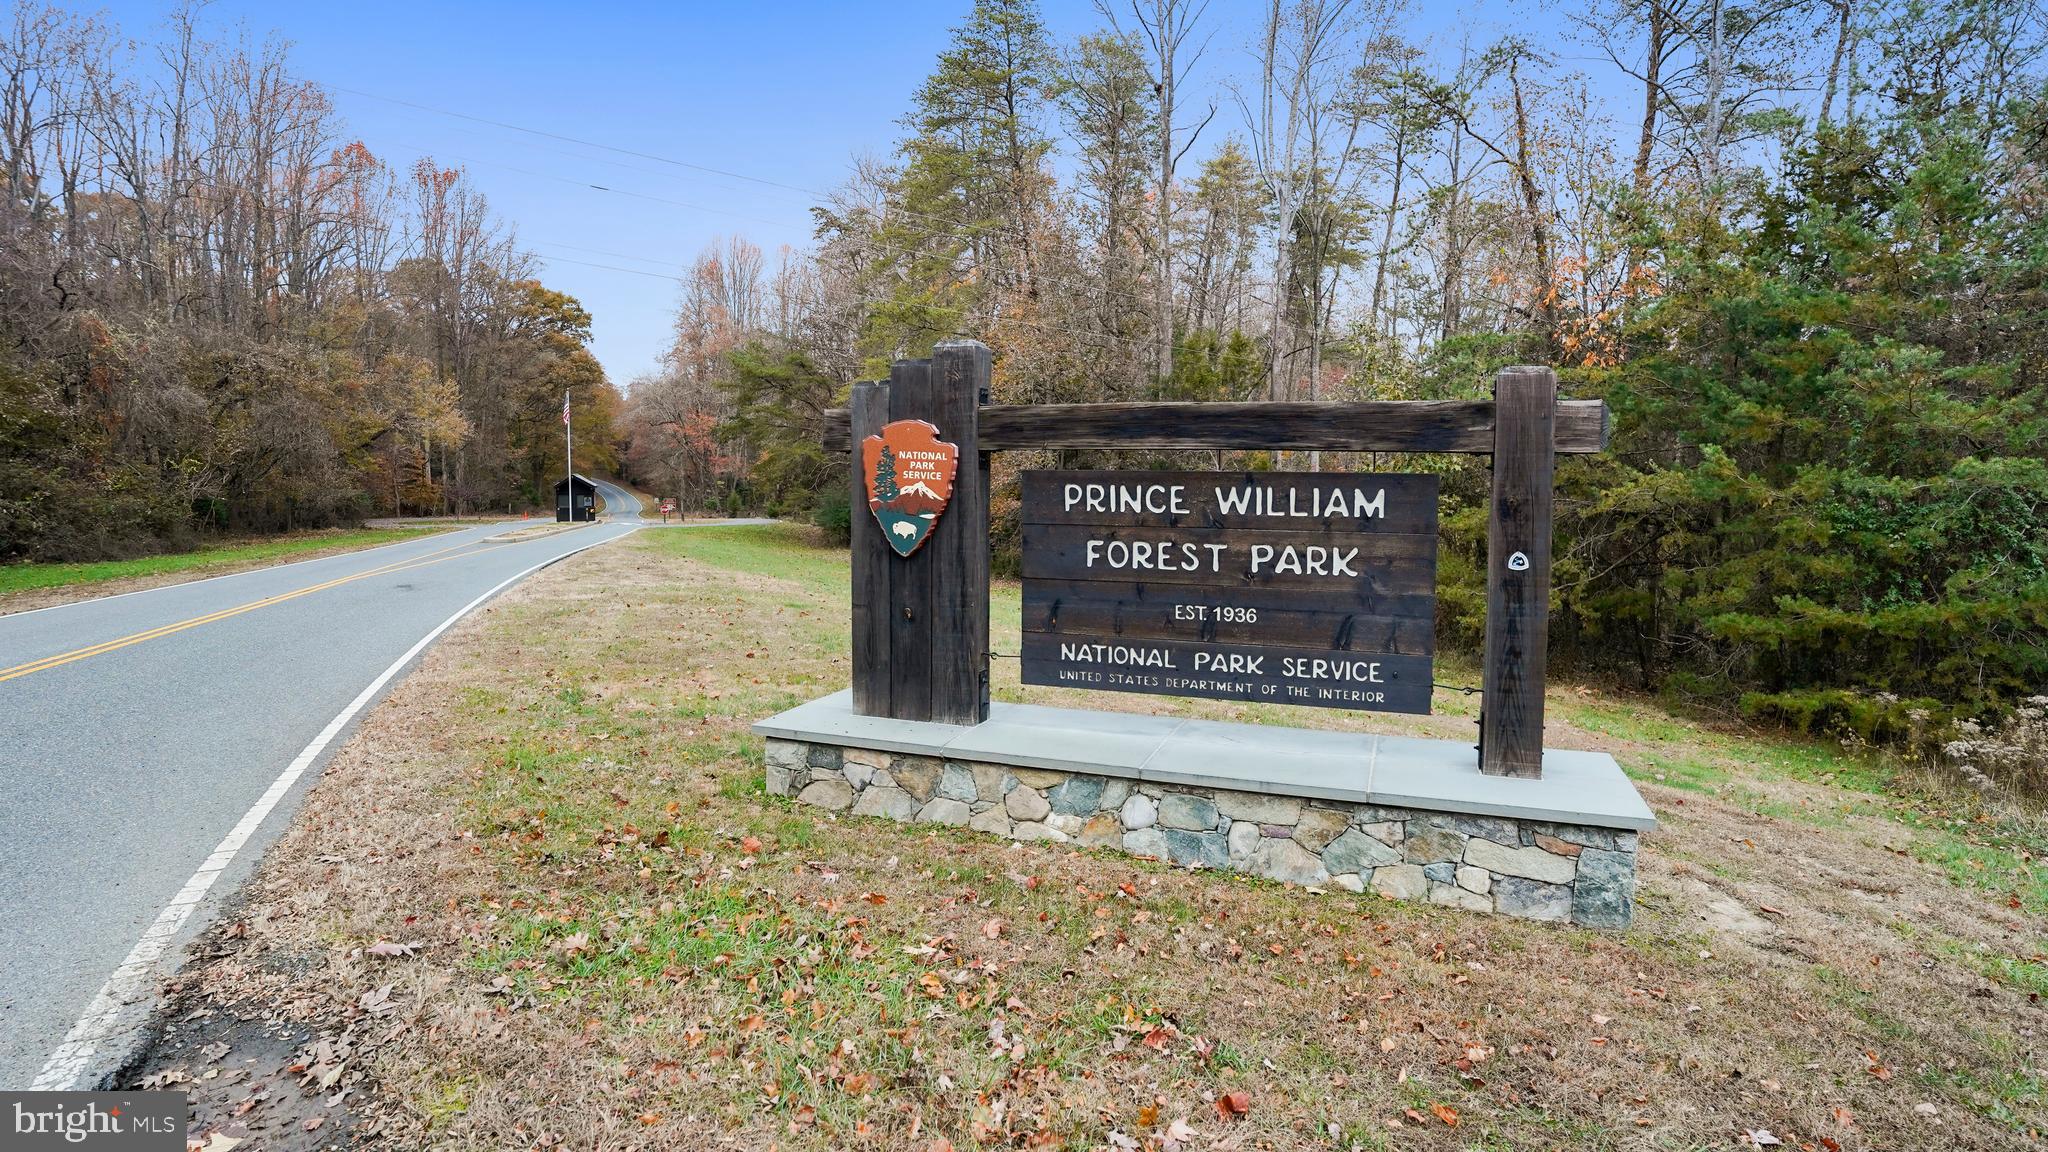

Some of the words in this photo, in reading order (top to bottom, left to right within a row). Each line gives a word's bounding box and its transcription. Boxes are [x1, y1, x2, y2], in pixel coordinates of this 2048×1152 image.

[899, 451, 947, 460] NATIONAL
[910, 461, 935, 470] PARK
[903, 471, 942, 480] SERVICE
[1064, 483, 1190, 514] PRINCE
[1214, 485, 1385, 519] WILLIAM
[1086, 540, 1228, 572] FOREST
[1250, 544, 1359, 577] PARK
[1175, 604, 1208, 621] EST.
[1212, 606, 1257, 623] 1936
[1060, 642, 1177, 668] NATIONAL
[1194, 652, 1264, 675] PARK
[1282, 657, 1385, 683] SERVICE
[1059, 670, 1102, 682] UNITED
[1108, 673, 1159, 687] STATES
[1165, 677, 1254, 693] DEPARTMENT
[1261, 684, 1278, 695] OF
[1286, 685, 1311, 698] THE
[1318, 688, 1385, 703] INTERIOR
